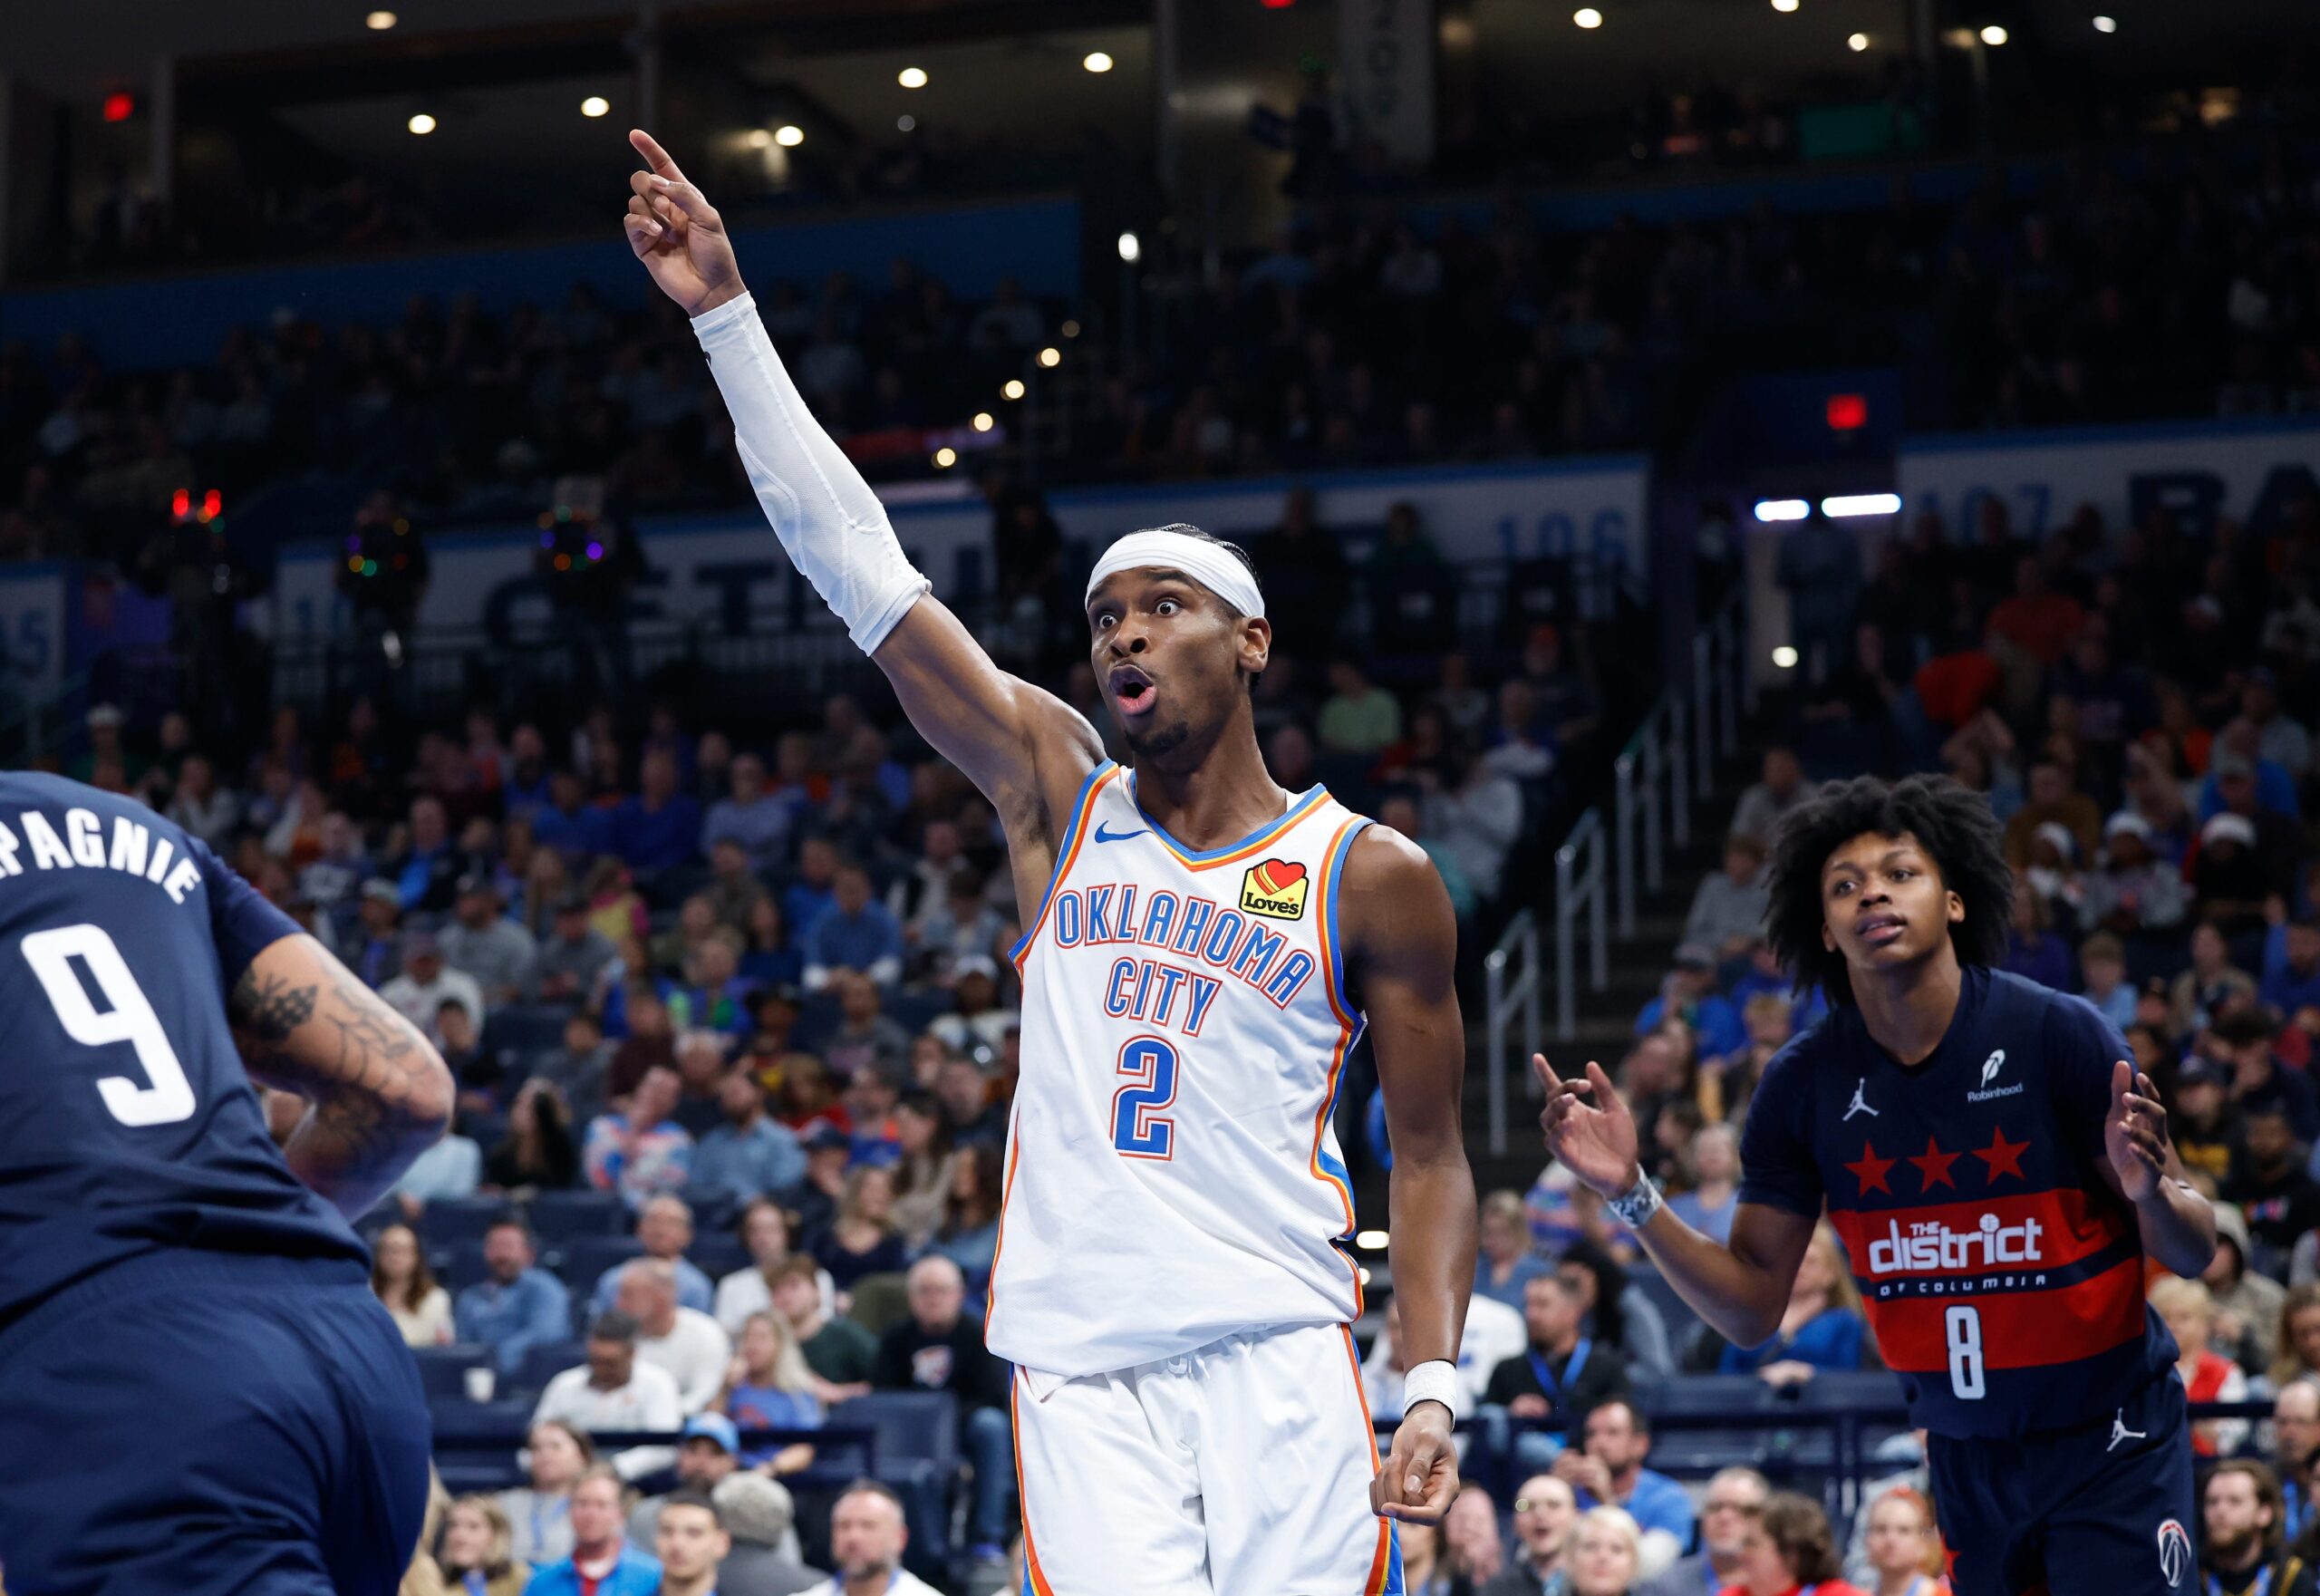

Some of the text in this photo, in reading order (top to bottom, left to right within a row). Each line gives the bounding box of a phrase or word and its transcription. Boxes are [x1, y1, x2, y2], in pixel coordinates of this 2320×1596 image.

[0, 808, 201, 904] PAGNIE
[1054, 884, 1316, 1011] OKLAHOMA
[21, 924, 197, 1127] 9
[1104, 957, 1223, 1037] CITY
[1110, 1035, 1179, 1160] 2
[1967, 1082, 2024, 1102] Robinhood
[1869, 1214, 2043, 1273] district
[1909, 1221, 1939, 1236] THE
[1880, 1274, 2046, 1296] OF COLUMBIA
[1945, 1305, 1986, 1399] 8
